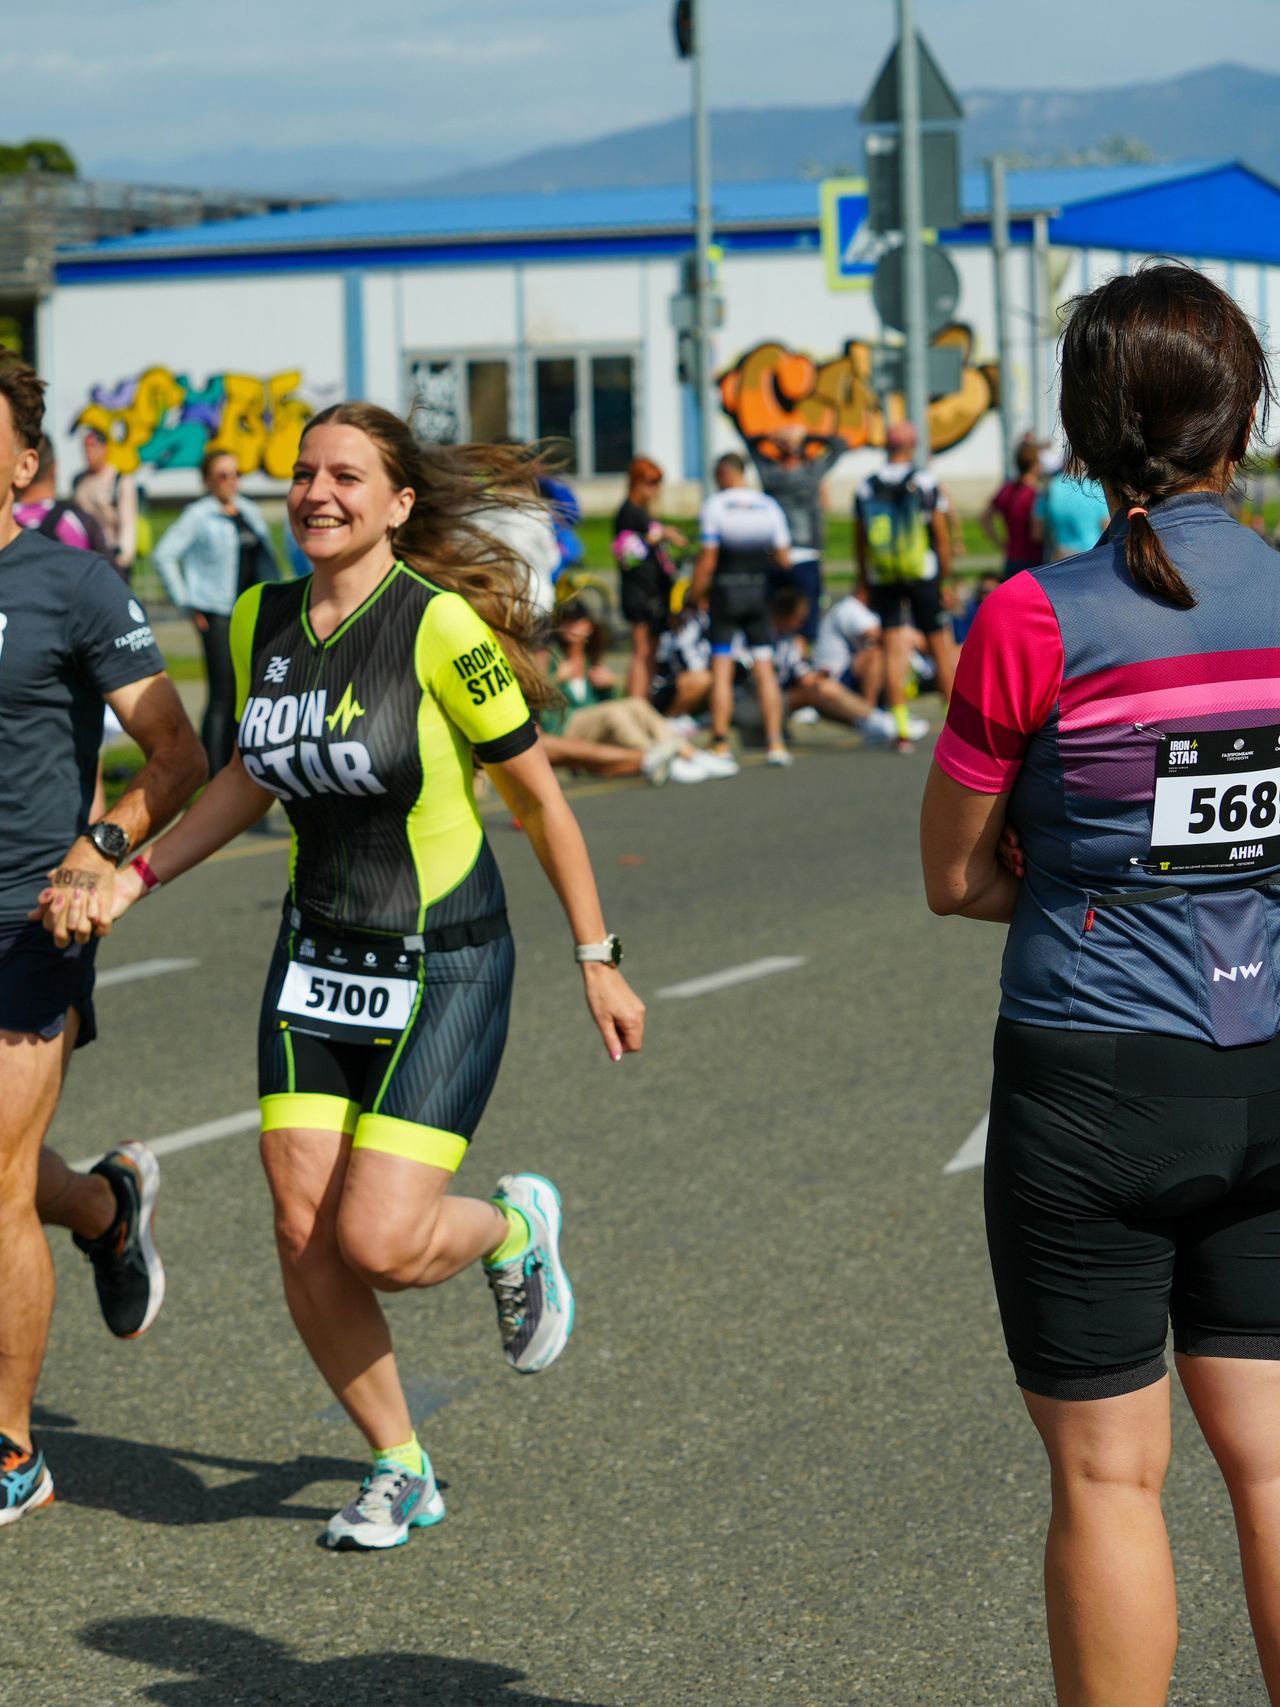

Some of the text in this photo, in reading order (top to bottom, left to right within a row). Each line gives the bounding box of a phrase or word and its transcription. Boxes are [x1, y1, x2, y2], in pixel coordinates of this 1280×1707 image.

[453, 641, 495, 679] IRON
[238, 689, 327, 748] IRON
[1169, 751, 1198, 765] STAR
[1170, 740, 1190, 751] IRON
[242, 740, 387, 800] STAR
[1188, 781, 1280, 834] 568
[1229, 844, 1264, 860] АННА
[1213, 961, 1263, 982] NW
[305, 976, 389, 1018] 5700
